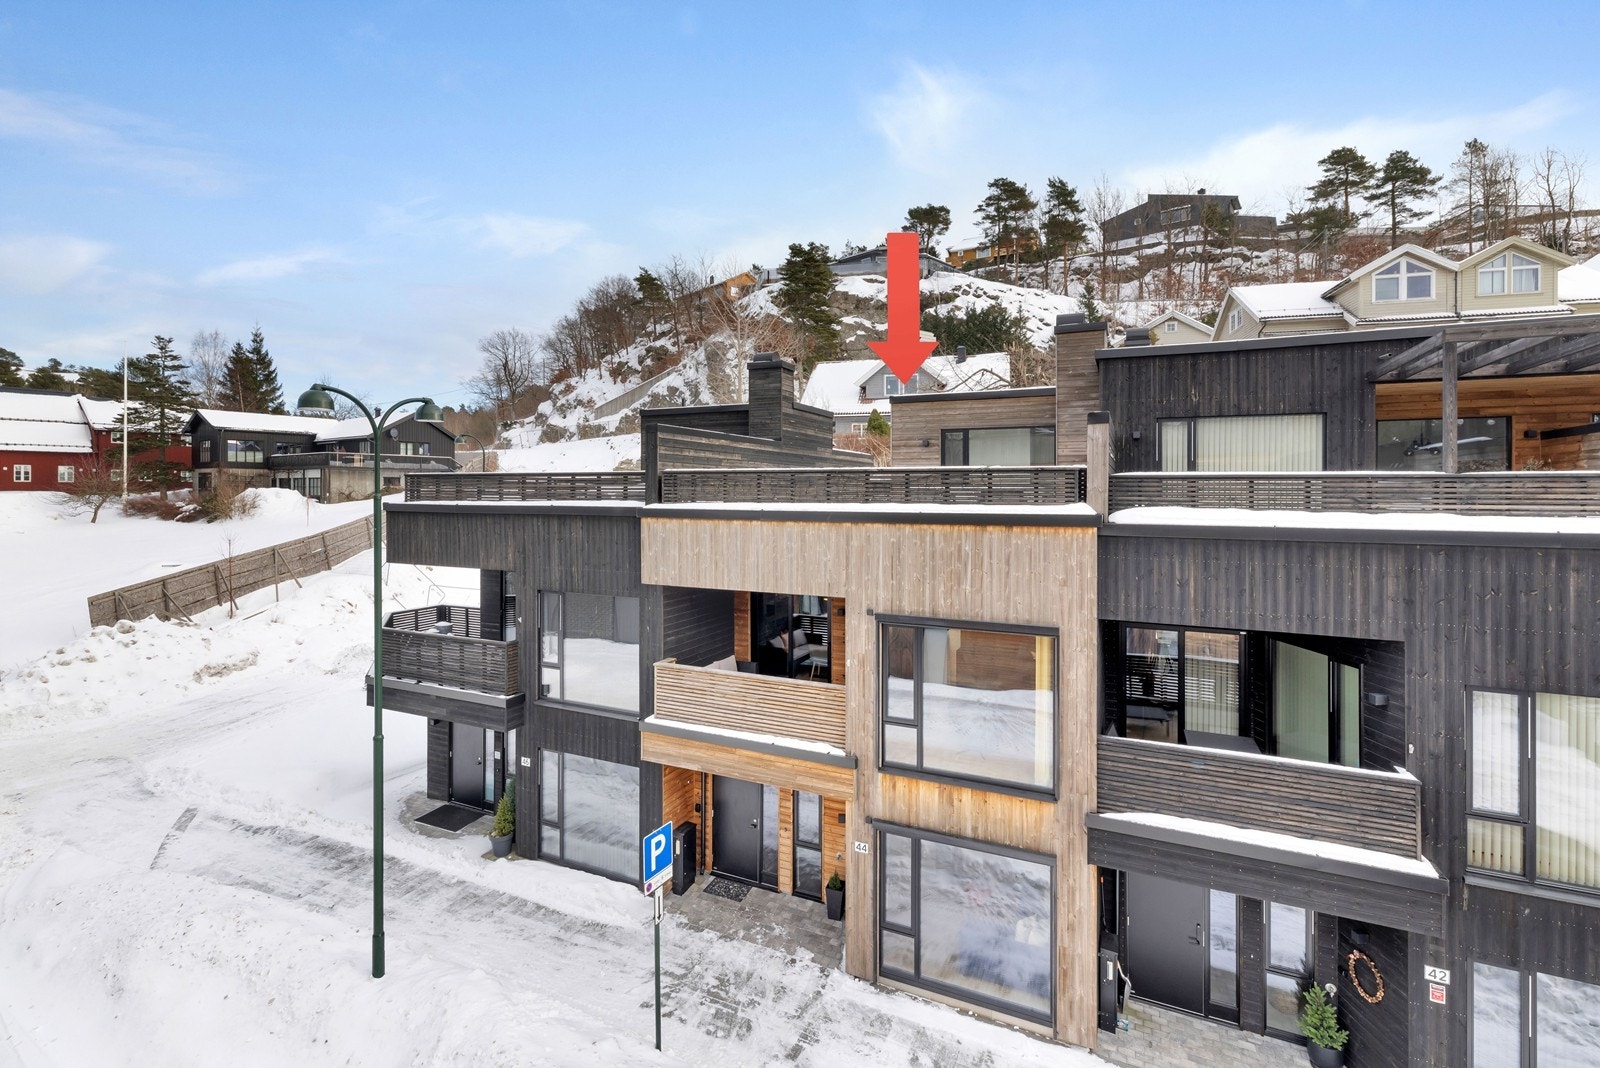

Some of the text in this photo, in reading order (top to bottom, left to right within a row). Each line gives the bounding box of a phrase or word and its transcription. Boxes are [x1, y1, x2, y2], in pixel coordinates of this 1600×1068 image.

[651, 833, 666, 872] P
[856, 843, 867, 852] 44
[1428, 969, 1447, 982] 42
